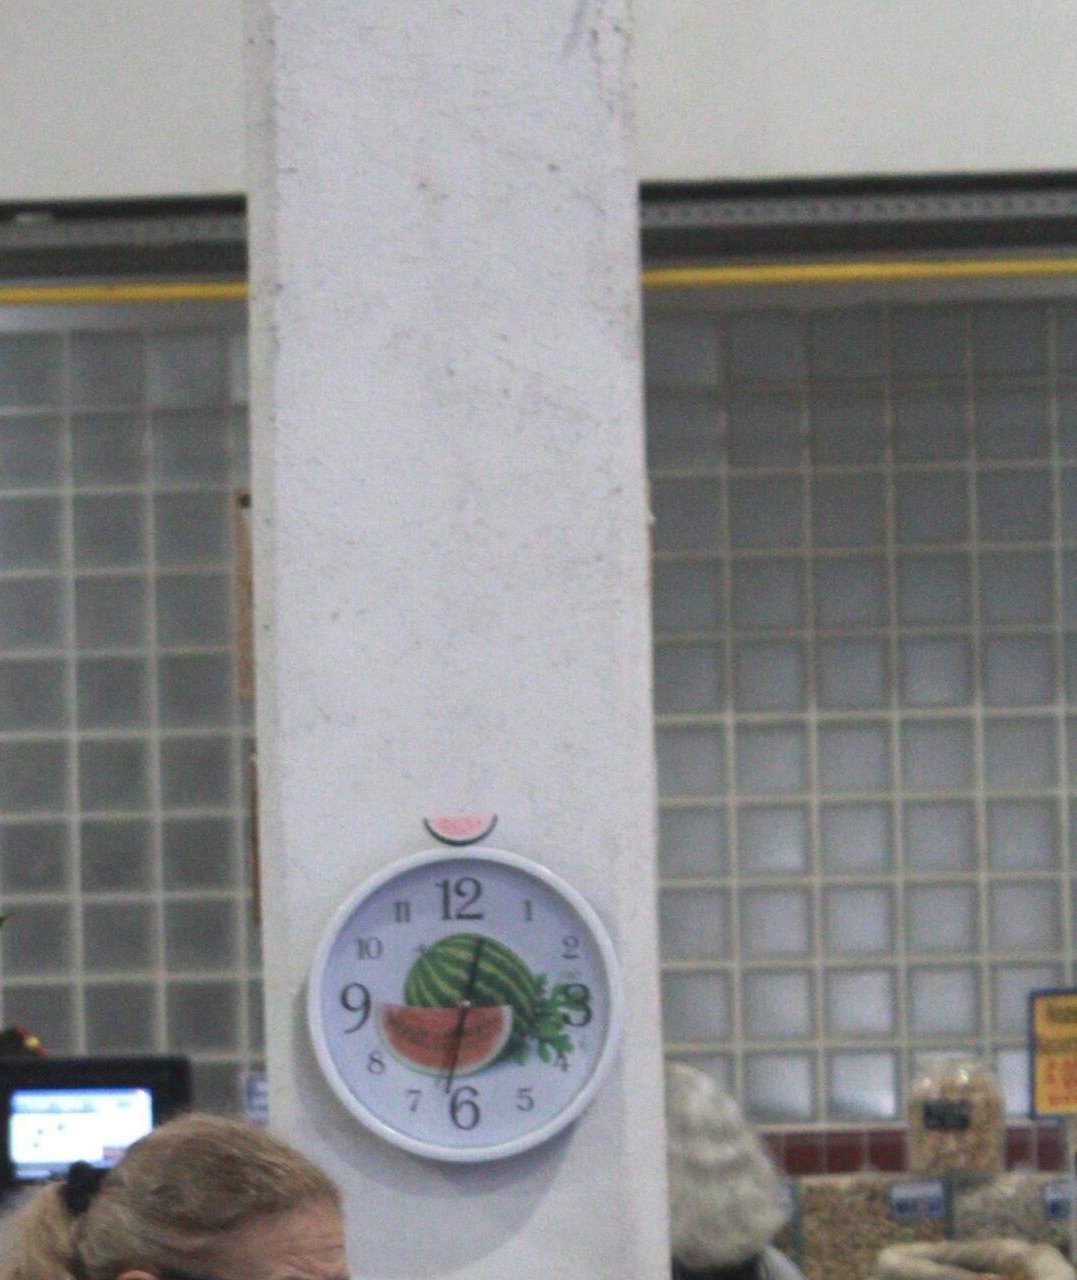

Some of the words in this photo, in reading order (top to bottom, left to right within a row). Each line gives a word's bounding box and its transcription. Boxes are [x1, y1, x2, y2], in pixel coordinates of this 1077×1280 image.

[435, 877, 484, 920] 12
[392, 901, 410, 922] 11
[523, 901, 533, 921] 1
[357, 937, 382, 960] 10
[562, 935, 580, 959] 2
[340, 983, 371, 1034] 9
[562, 982, 593, 1027] 3
[367, 1052, 385, 1075] 8
[553, 1050, 570, 1072] 4
[408, 1089, 421, 1112] 7
[449, 1086, 480, 1130] 6
[516, 1088, 534, 1111] 5
